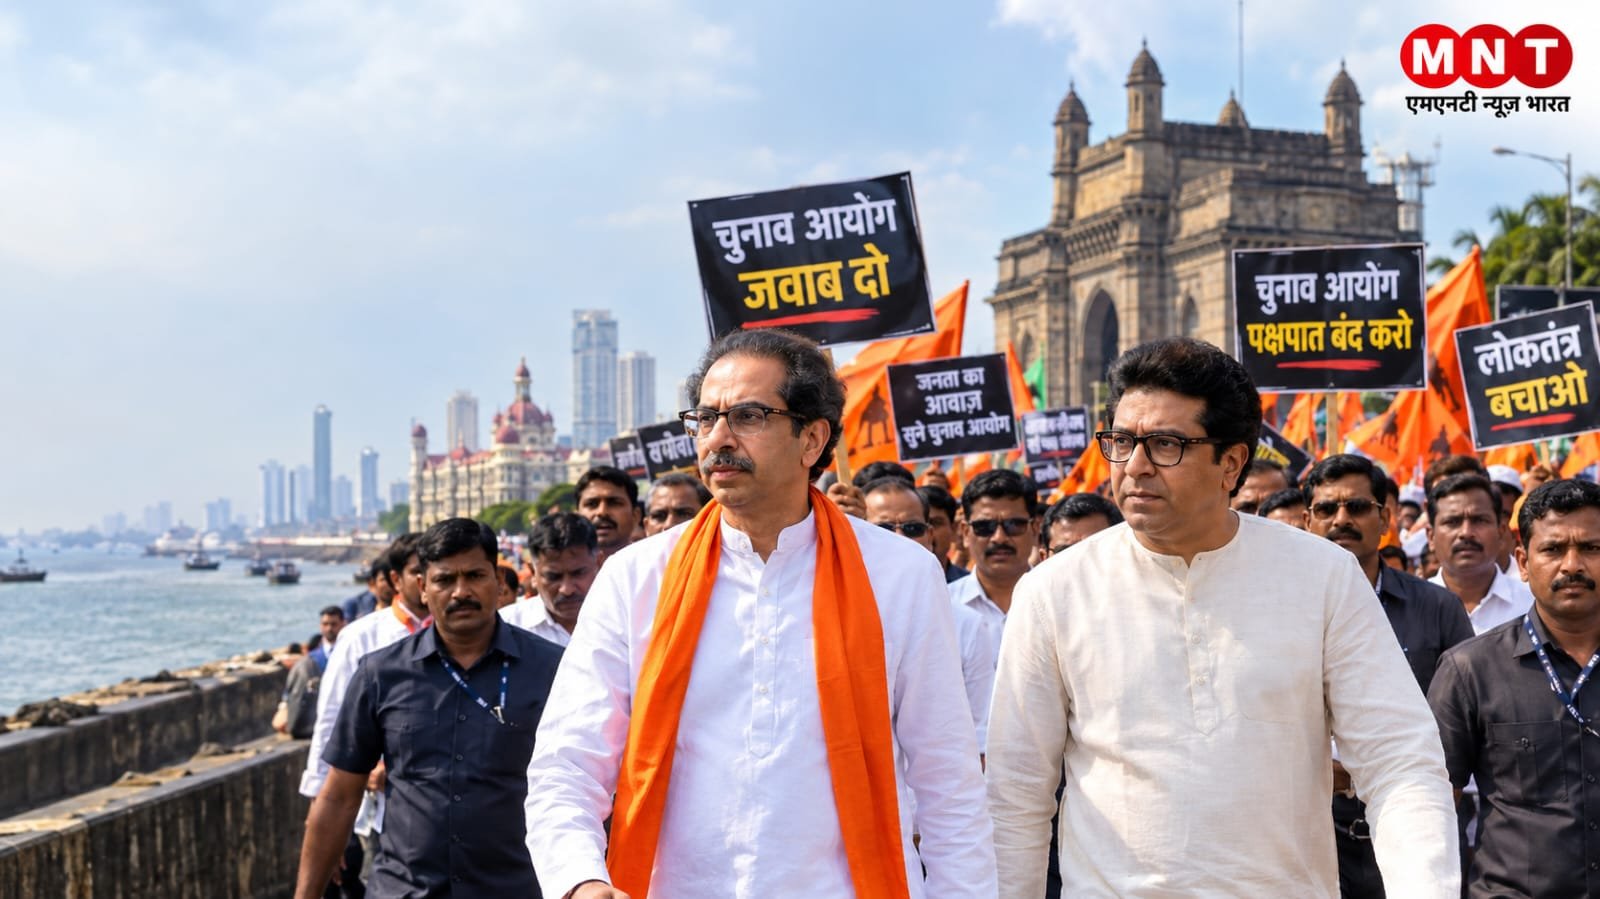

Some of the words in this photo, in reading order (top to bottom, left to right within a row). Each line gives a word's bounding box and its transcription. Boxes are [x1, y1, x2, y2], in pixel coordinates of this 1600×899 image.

[712, 211, 795, 265] चुनाव
[738, 260, 844, 311] जवाब
[848, 242, 891, 299] दो
[1254, 272, 1318, 316] चुनाव
[1246, 320, 1327, 356] पक्षपात
[1329, 311, 1365, 352] बंद
[1367, 308, 1414, 350] करो
[1473, 320, 1582, 376] लोकतंत्र
[915, 370, 960, 391] जनता
[961, 367, 985, 386] का
[924, 389, 983, 415] आवाज़
[1484, 360, 1589, 419] बचाओ
[927, 420, 965, 446] चुनाव
[967, 411, 1011, 436] आयोग
